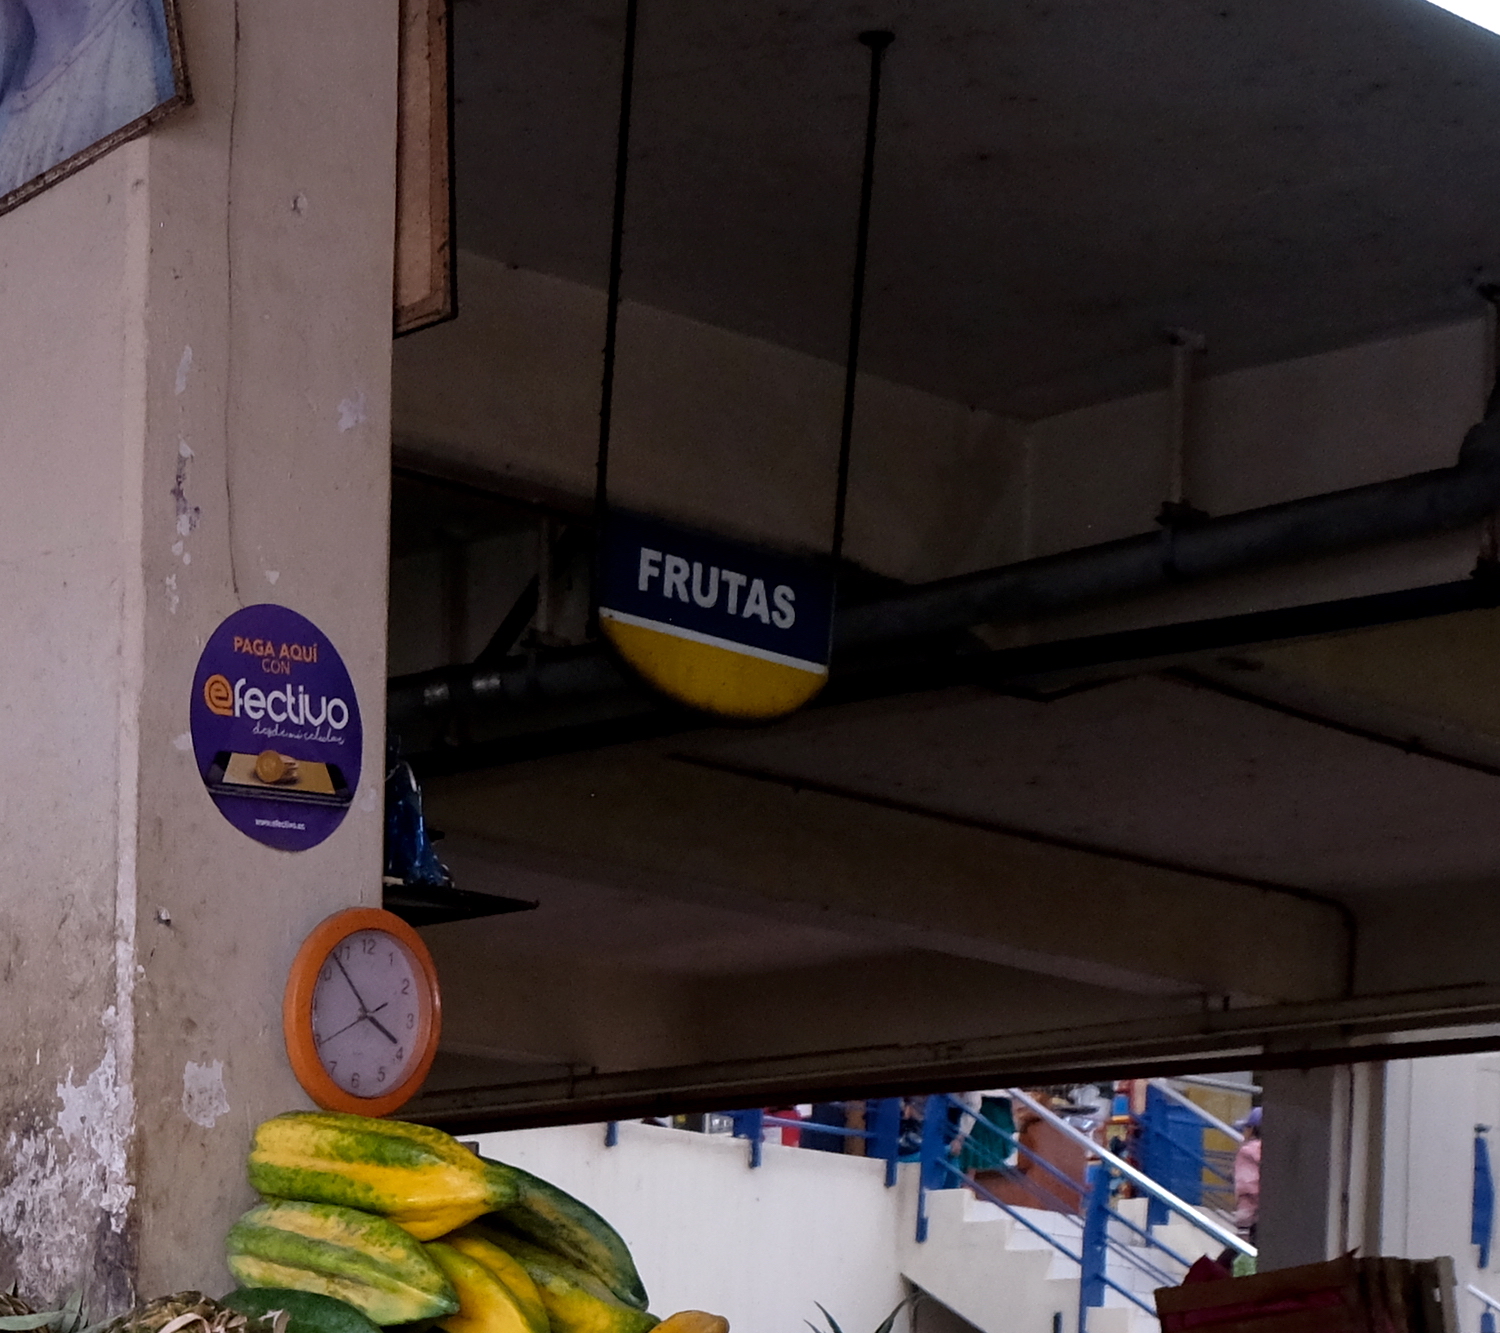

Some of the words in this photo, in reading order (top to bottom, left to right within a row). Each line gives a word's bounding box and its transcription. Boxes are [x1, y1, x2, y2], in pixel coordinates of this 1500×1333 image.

[638, 547, 796, 629] FRUTAS
[233, 636, 275, 657] PAGA
[279, 643, 318, 663] AQUÍ
[262, 658, 291, 675] CON
[204, 673, 349, 730] efectivo
[401, 978, 410, 995] 2
[406, 1013, 414, 1029] 3
[378, 1067, 386, 1082] 5
